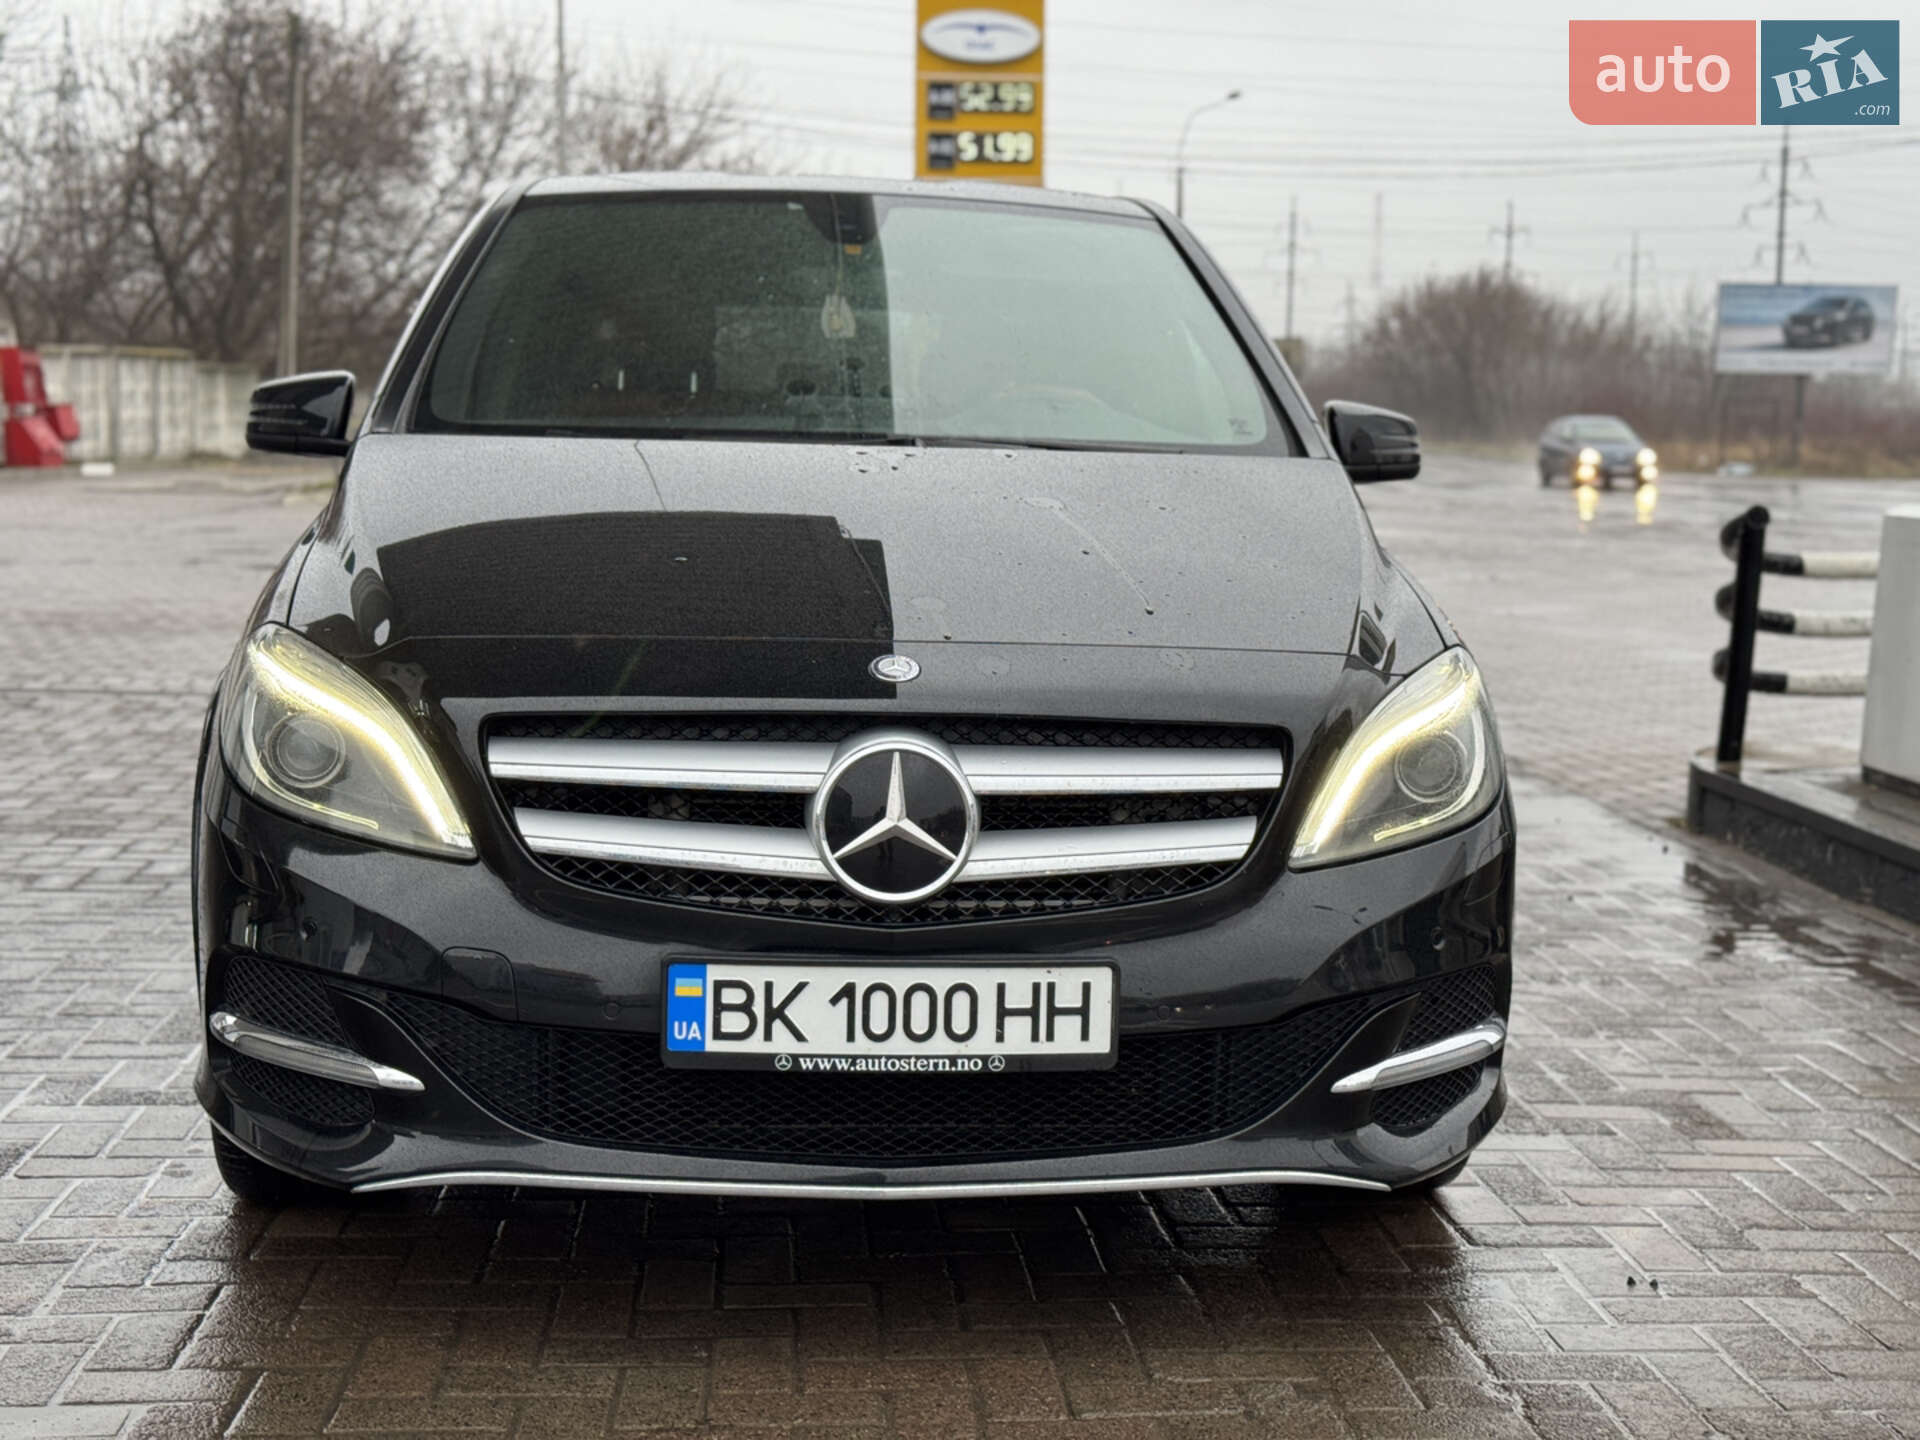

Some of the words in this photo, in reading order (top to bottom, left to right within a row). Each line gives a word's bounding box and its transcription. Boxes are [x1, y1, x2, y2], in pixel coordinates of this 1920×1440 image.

[711, 979, 810, 1043] BK
[828, 981, 979, 1043] 1000
[995, 981, 1091, 1043] HH
[673, 1021, 702, 1041] UA
[799, 1055, 983, 1073] www.autostern.no
